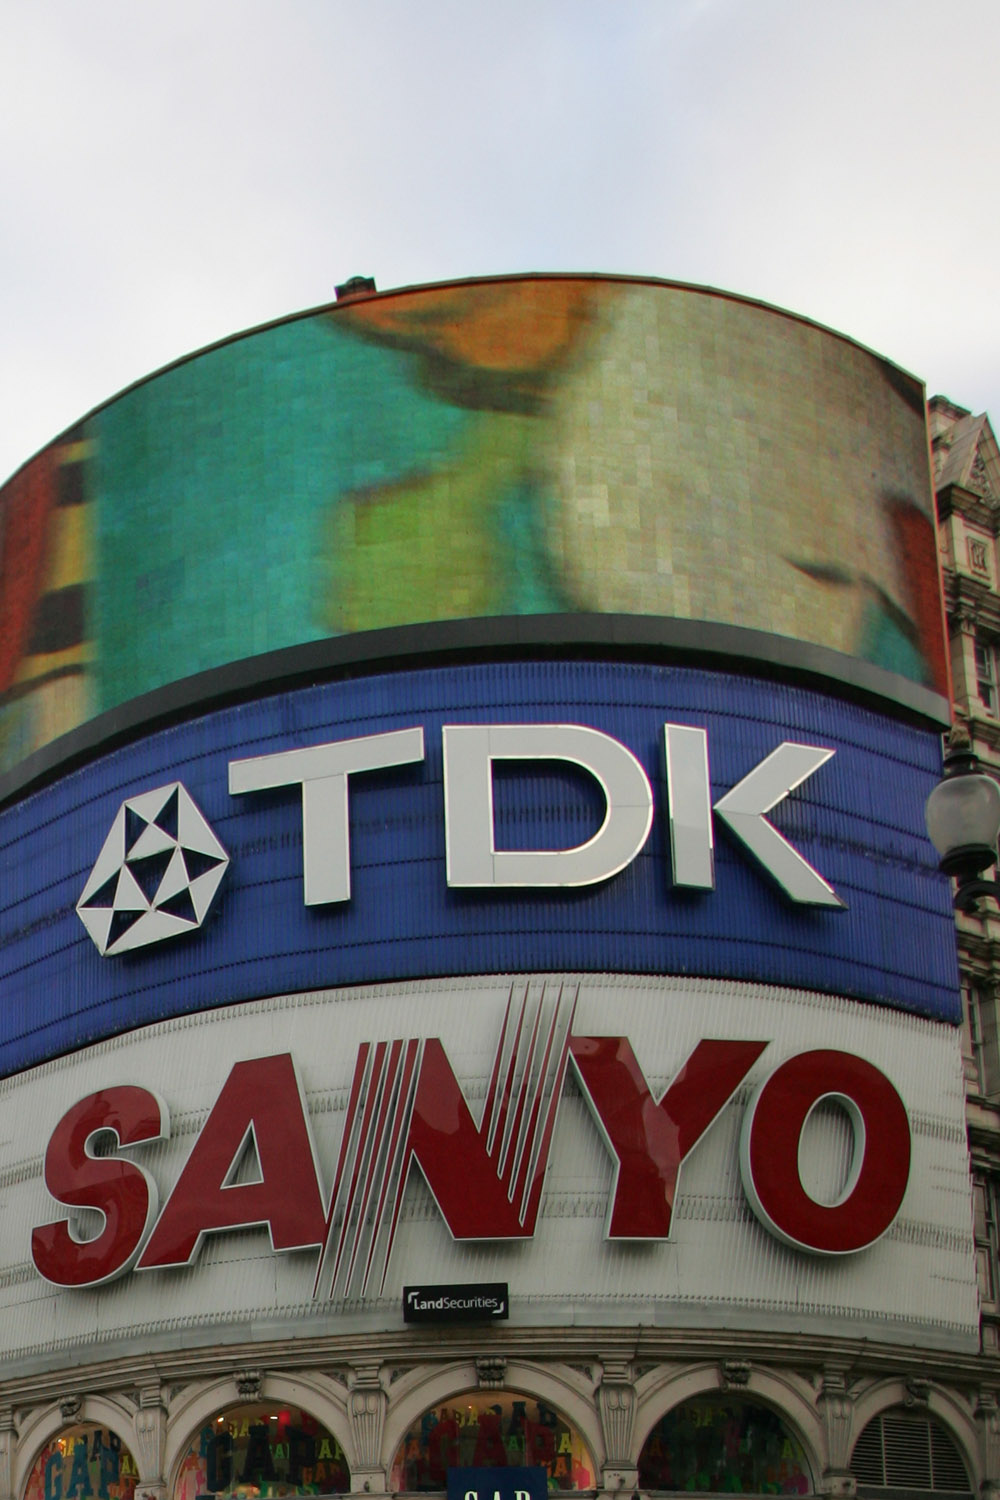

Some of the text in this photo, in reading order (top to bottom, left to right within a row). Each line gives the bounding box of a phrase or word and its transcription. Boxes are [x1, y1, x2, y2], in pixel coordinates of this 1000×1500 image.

[228, 723, 849, 911] TDK
[31, 982, 913, 1299] SANYO
[413, 1291, 498, 1310] LandSecurities
